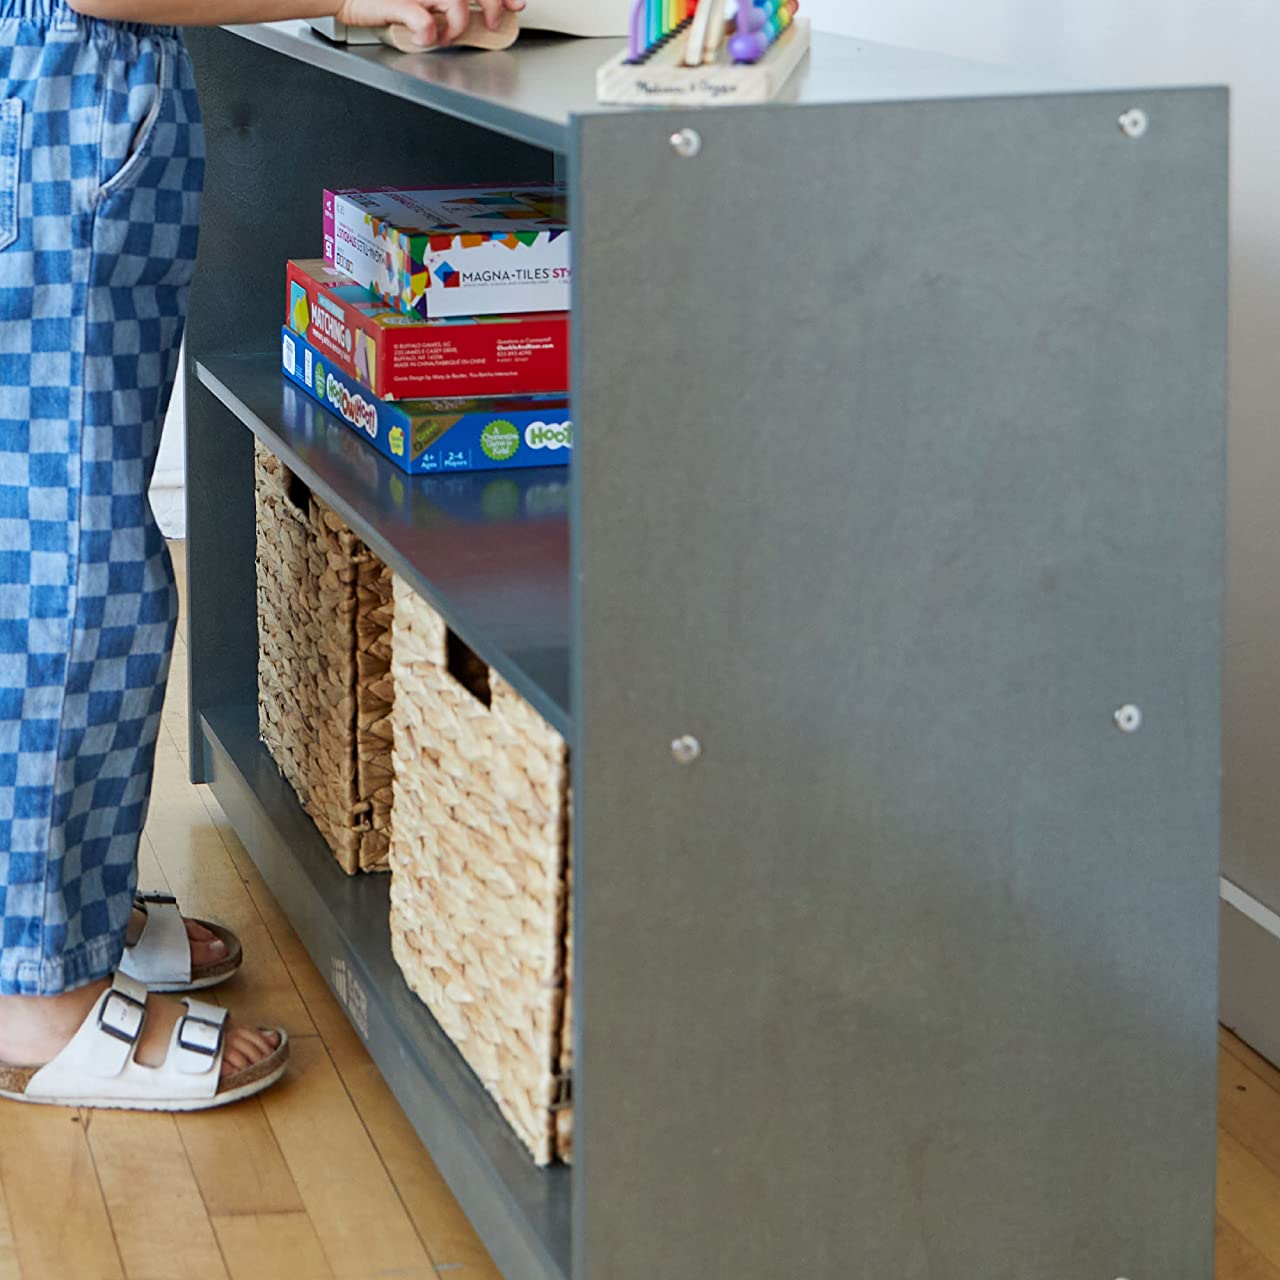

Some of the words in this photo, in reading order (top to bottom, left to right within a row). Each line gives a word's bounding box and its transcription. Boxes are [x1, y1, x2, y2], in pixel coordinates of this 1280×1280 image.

[462, 268, 549, 282] MAGNA-TILES
[422, 453, 435, 461] 4+
[448, 451, 464, 460] 2-4
[444, 459, 468, 468] Players
